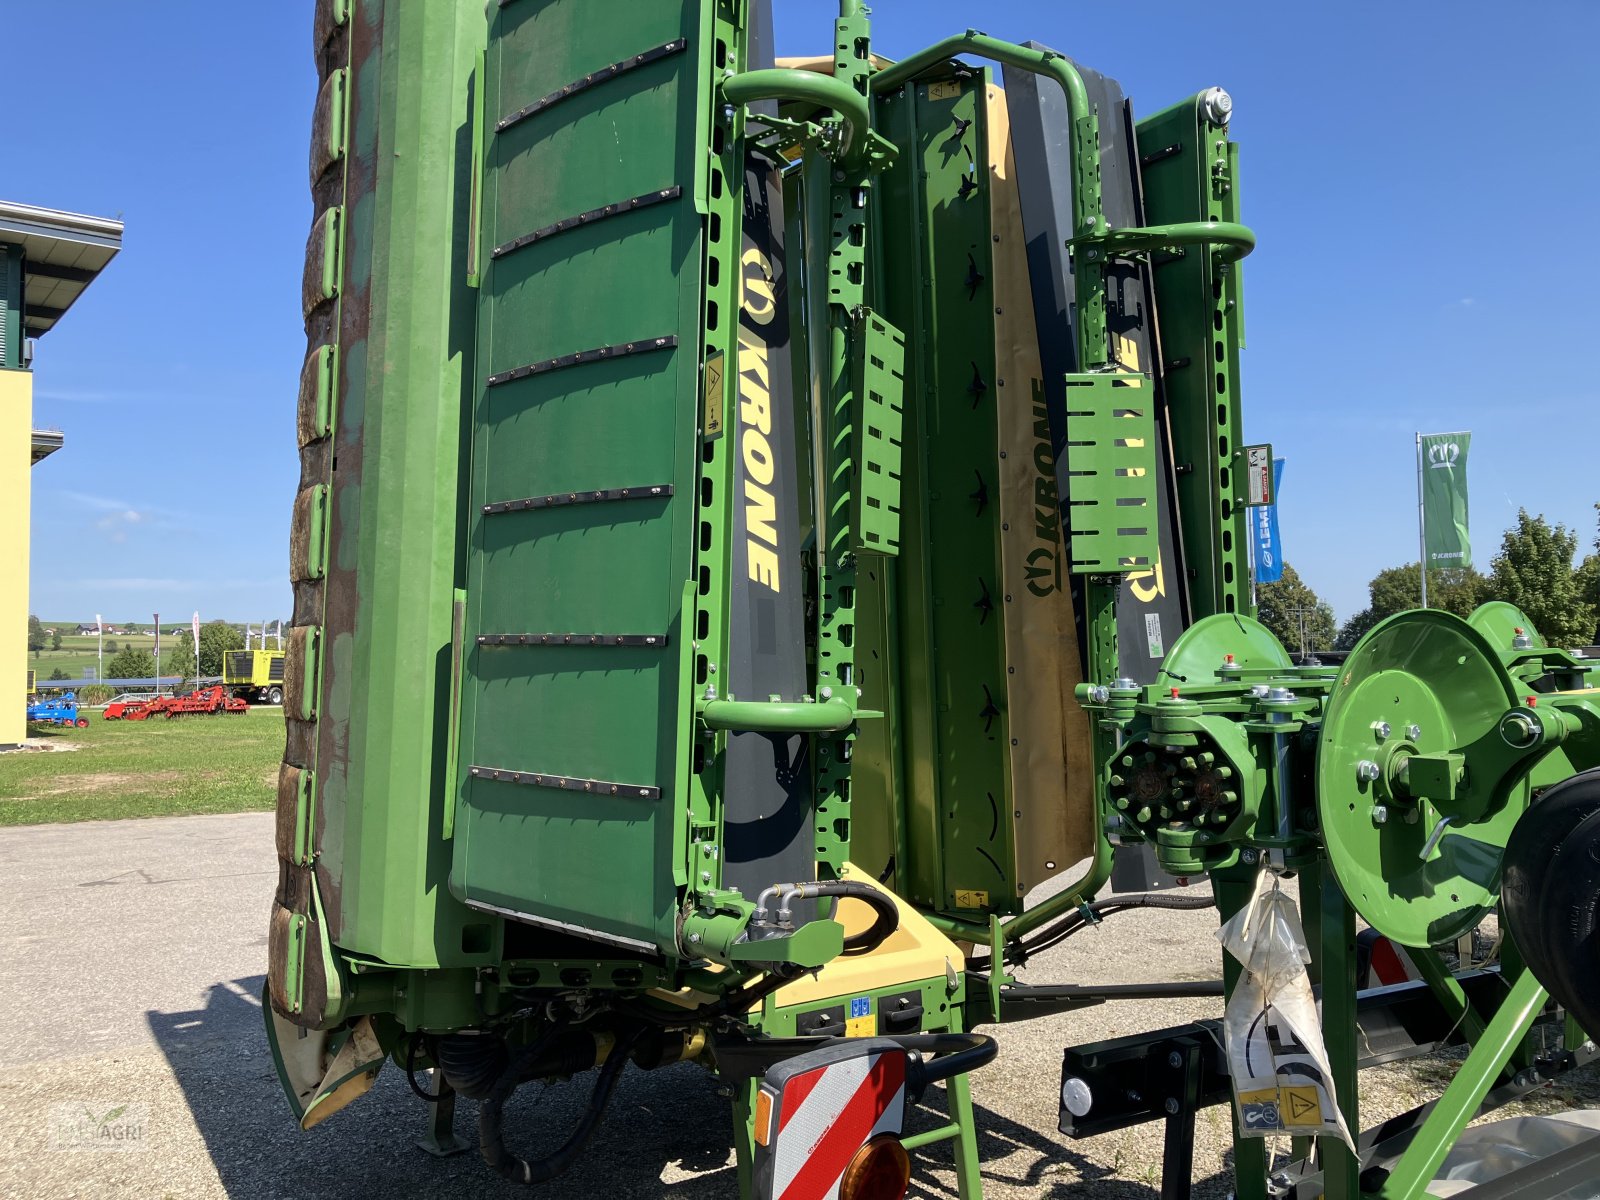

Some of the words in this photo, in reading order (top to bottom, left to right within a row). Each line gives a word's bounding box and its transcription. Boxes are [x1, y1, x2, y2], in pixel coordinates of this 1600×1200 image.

[738, 322, 780, 593] KRONE
[1031, 377, 1061, 545] KRONE
[1259, 506, 1271, 549] LEM
[1437, 551, 1465, 560] KRONE
